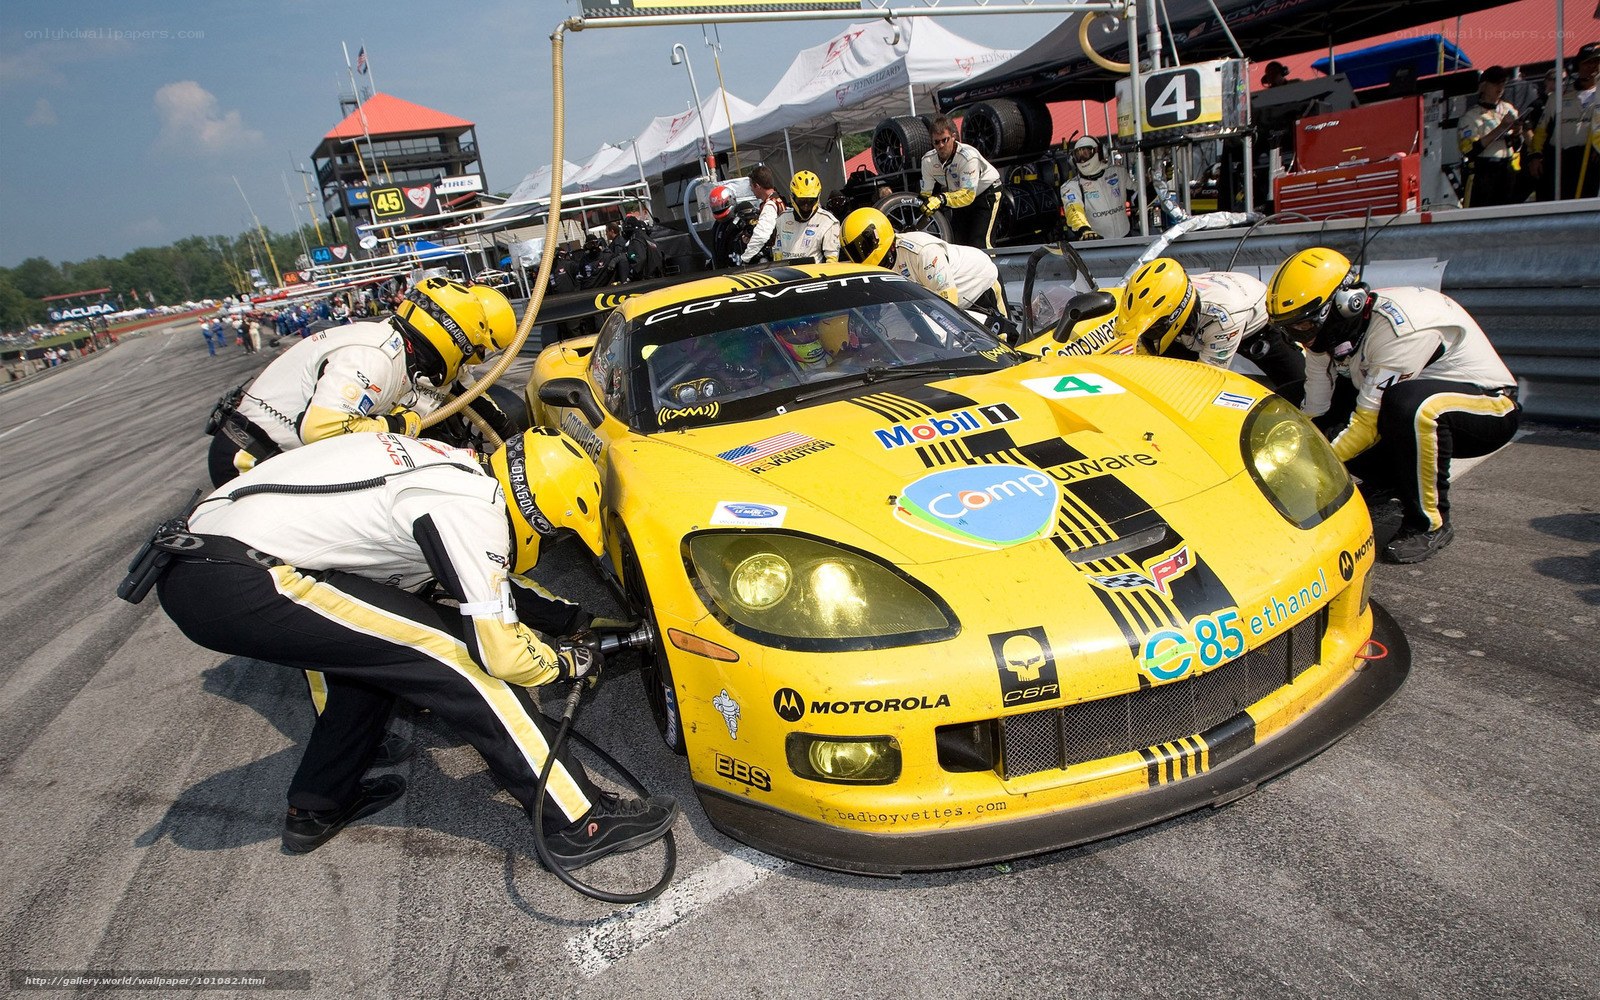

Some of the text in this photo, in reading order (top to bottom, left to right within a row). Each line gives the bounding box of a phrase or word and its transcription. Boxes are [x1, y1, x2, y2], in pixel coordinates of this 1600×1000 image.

[853, 65, 901, 90] FLYING LIZARD
[1150, 74, 1195, 121] 4
[443, 179, 474, 190] TIRES
[376, 192, 401, 211] 45
[314, 249, 330, 261] 44
[62, 303, 115, 320] ACURA
[645, 273, 909, 326] CORVETTE
[442, 318, 468, 347] DRAGON
[1053, 376, 1104, 394] 4
[873, 405, 1009, 451] Mobil 1
[510, 465, 536, 515] DRAGON
[1354, 535, 1375, 564] MOTO
[1250, 568, 1329, 636] ethanol
[810, 694, 951, 714] MOTOROLA
[1003, 683, 1058, 704] C6R
[715, 753, 772, 792] BBS
[838, 799, 1008, 824] badboyvettes.com
